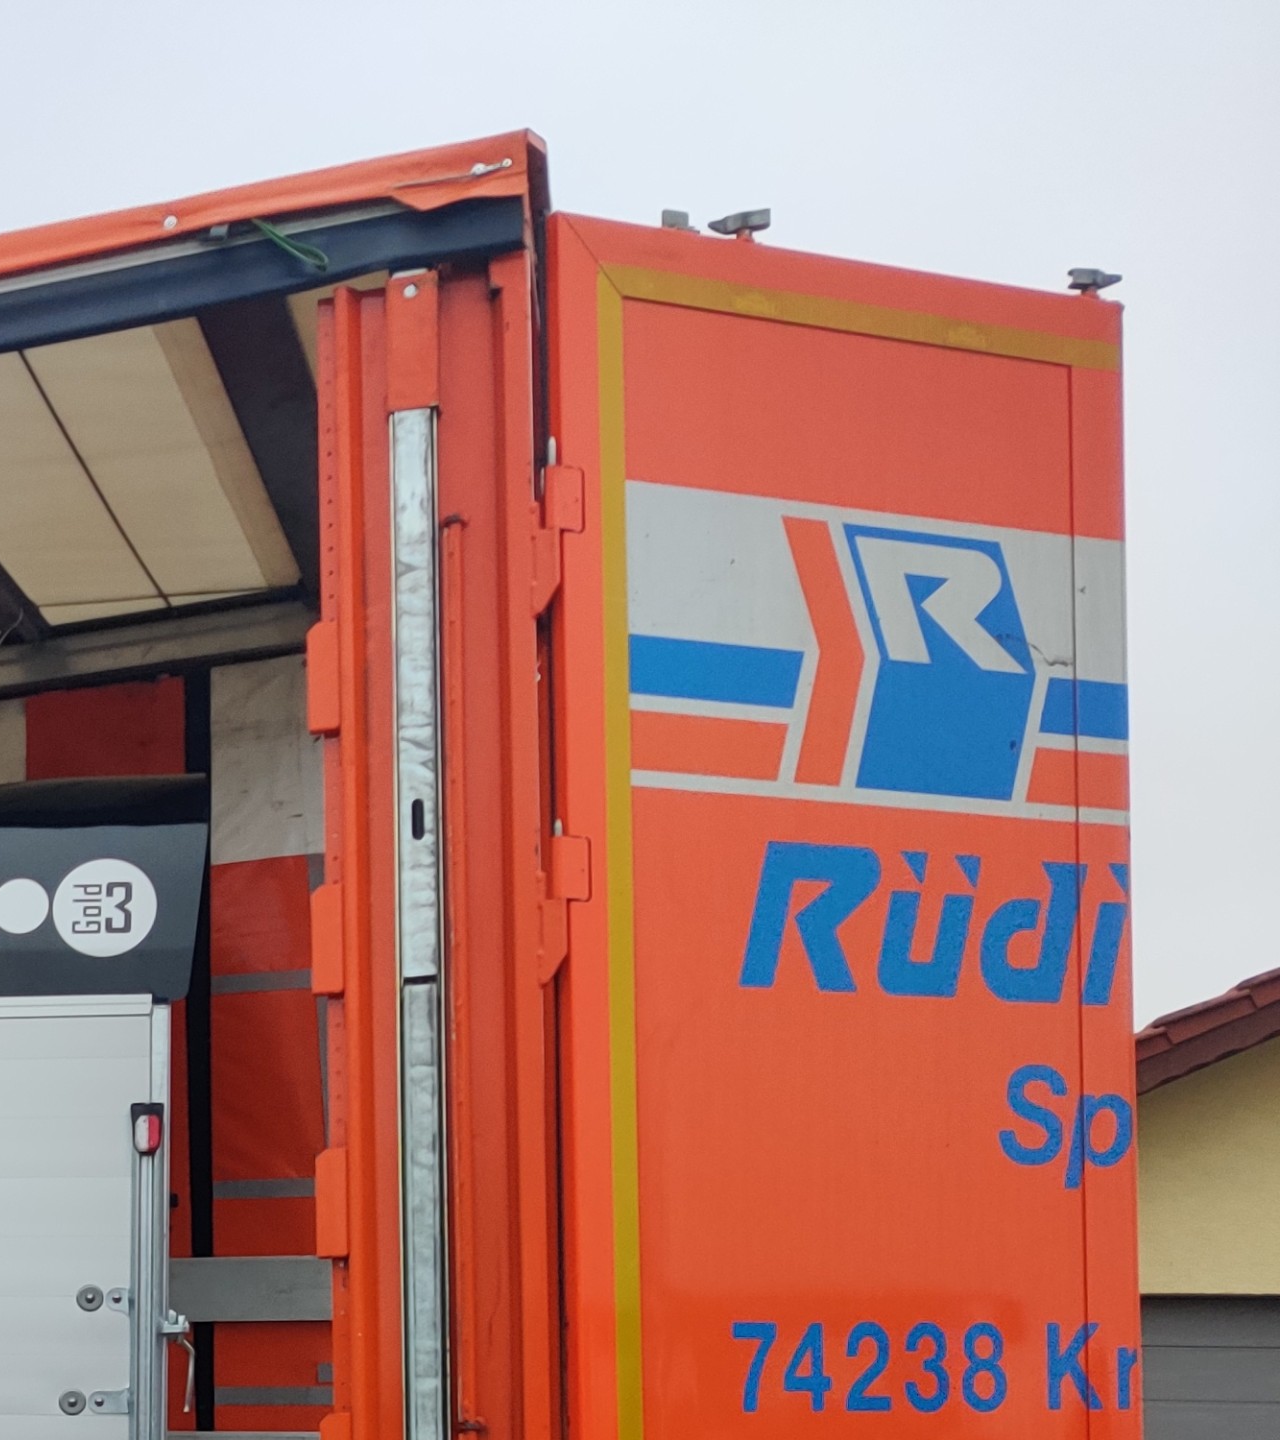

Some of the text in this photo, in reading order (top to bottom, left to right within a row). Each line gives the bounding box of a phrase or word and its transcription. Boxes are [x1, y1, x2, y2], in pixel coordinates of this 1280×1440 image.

[854, 535, 1027, 674] R
[72, 884, 102, 934] Gold
[105, 881, 132, 933] 3
[738, 840, 1129, 1006] Rüdi
[998, 1063, 1133, 1189] Sp
[731, 1321, 1137, 1413] 74238 Kr
